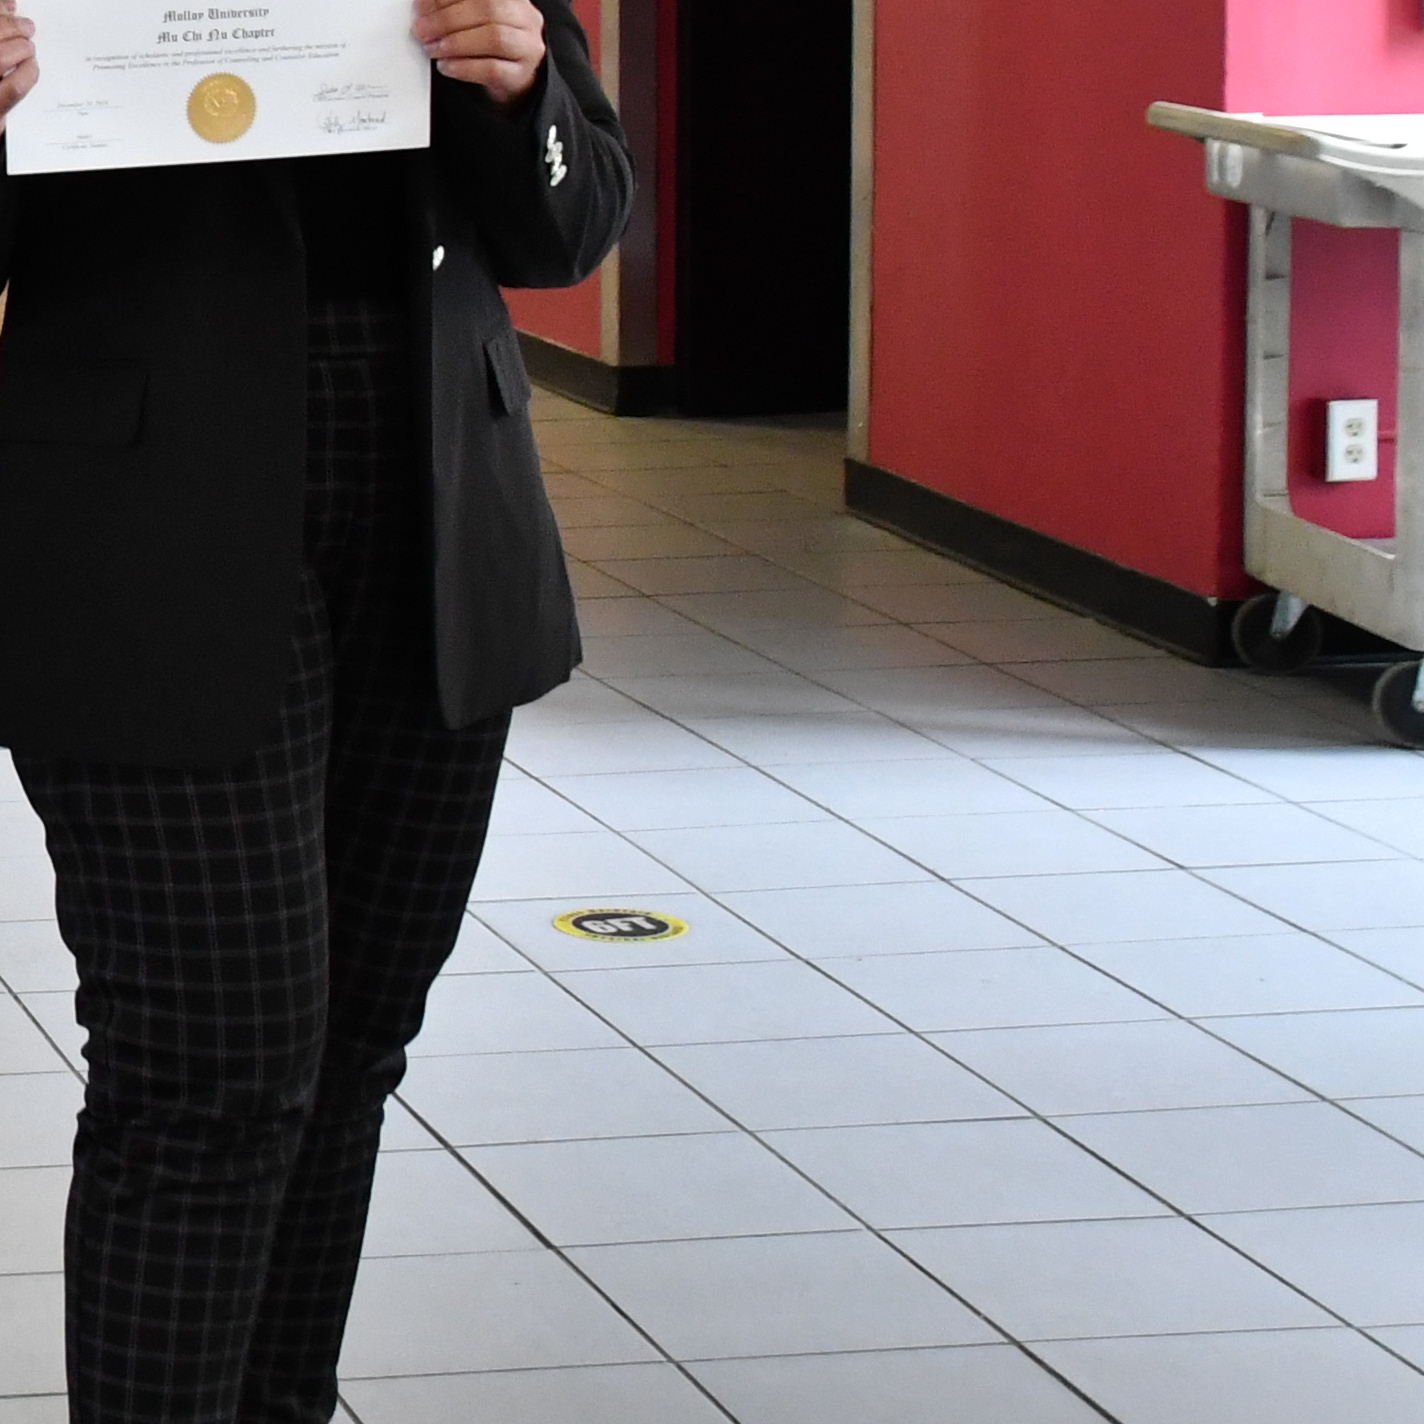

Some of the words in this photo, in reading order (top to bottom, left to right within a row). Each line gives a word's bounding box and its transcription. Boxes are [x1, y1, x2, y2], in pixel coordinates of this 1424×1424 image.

[163, 8, 204, 23] Molloy
[207, 7, 269, 21] University
[157, 30, 178, 44] Mu
[182, 29, 203, 42] Chi
[231, 27, 275, 41] Chapter
